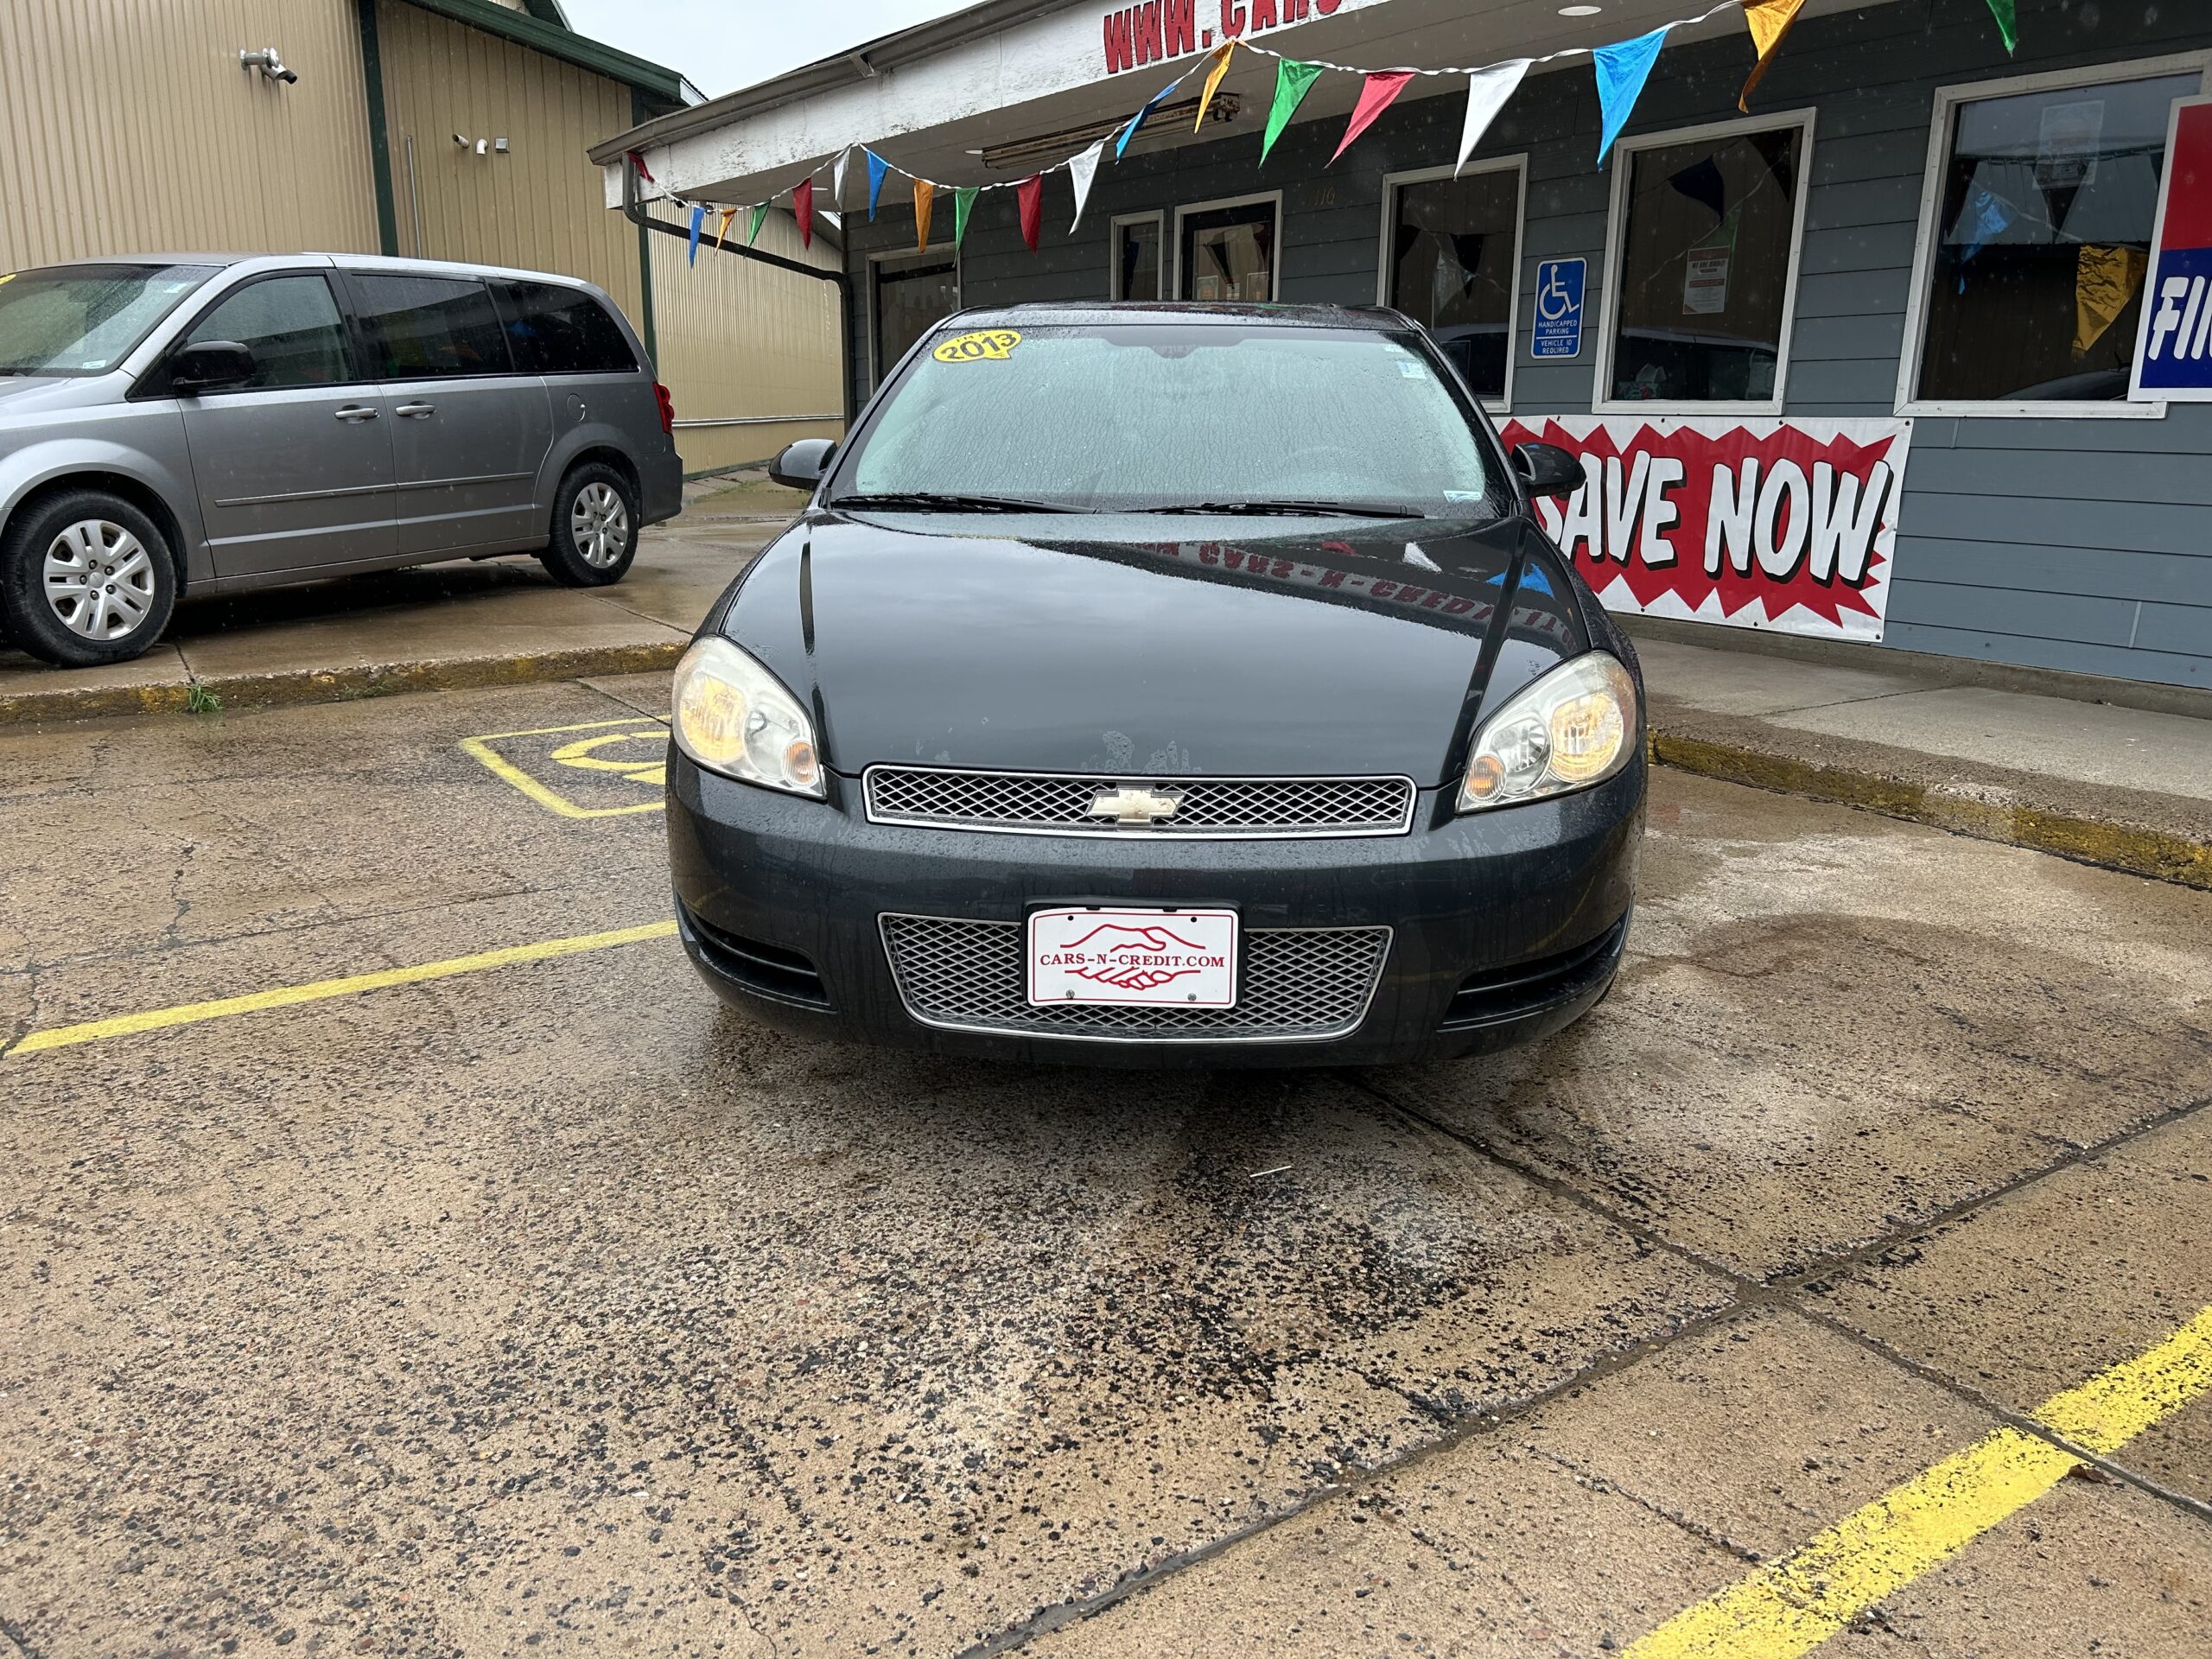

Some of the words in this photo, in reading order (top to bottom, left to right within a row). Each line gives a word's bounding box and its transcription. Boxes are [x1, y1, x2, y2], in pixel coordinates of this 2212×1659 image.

[1103, 0, 1341, 74] WWW.CA
[1538, 319, 1578, 328] HANDICAPPED
[940, 333, 1017, 359] 2013
[1541, 339, 1564, 347] VEHICLE
[1541, 346, 1569, 355] REQUIRED
[1703, 456, 1892, 586] NOW
[1039, 952, 1225, 968] CARS-N-CREDIT.COM
